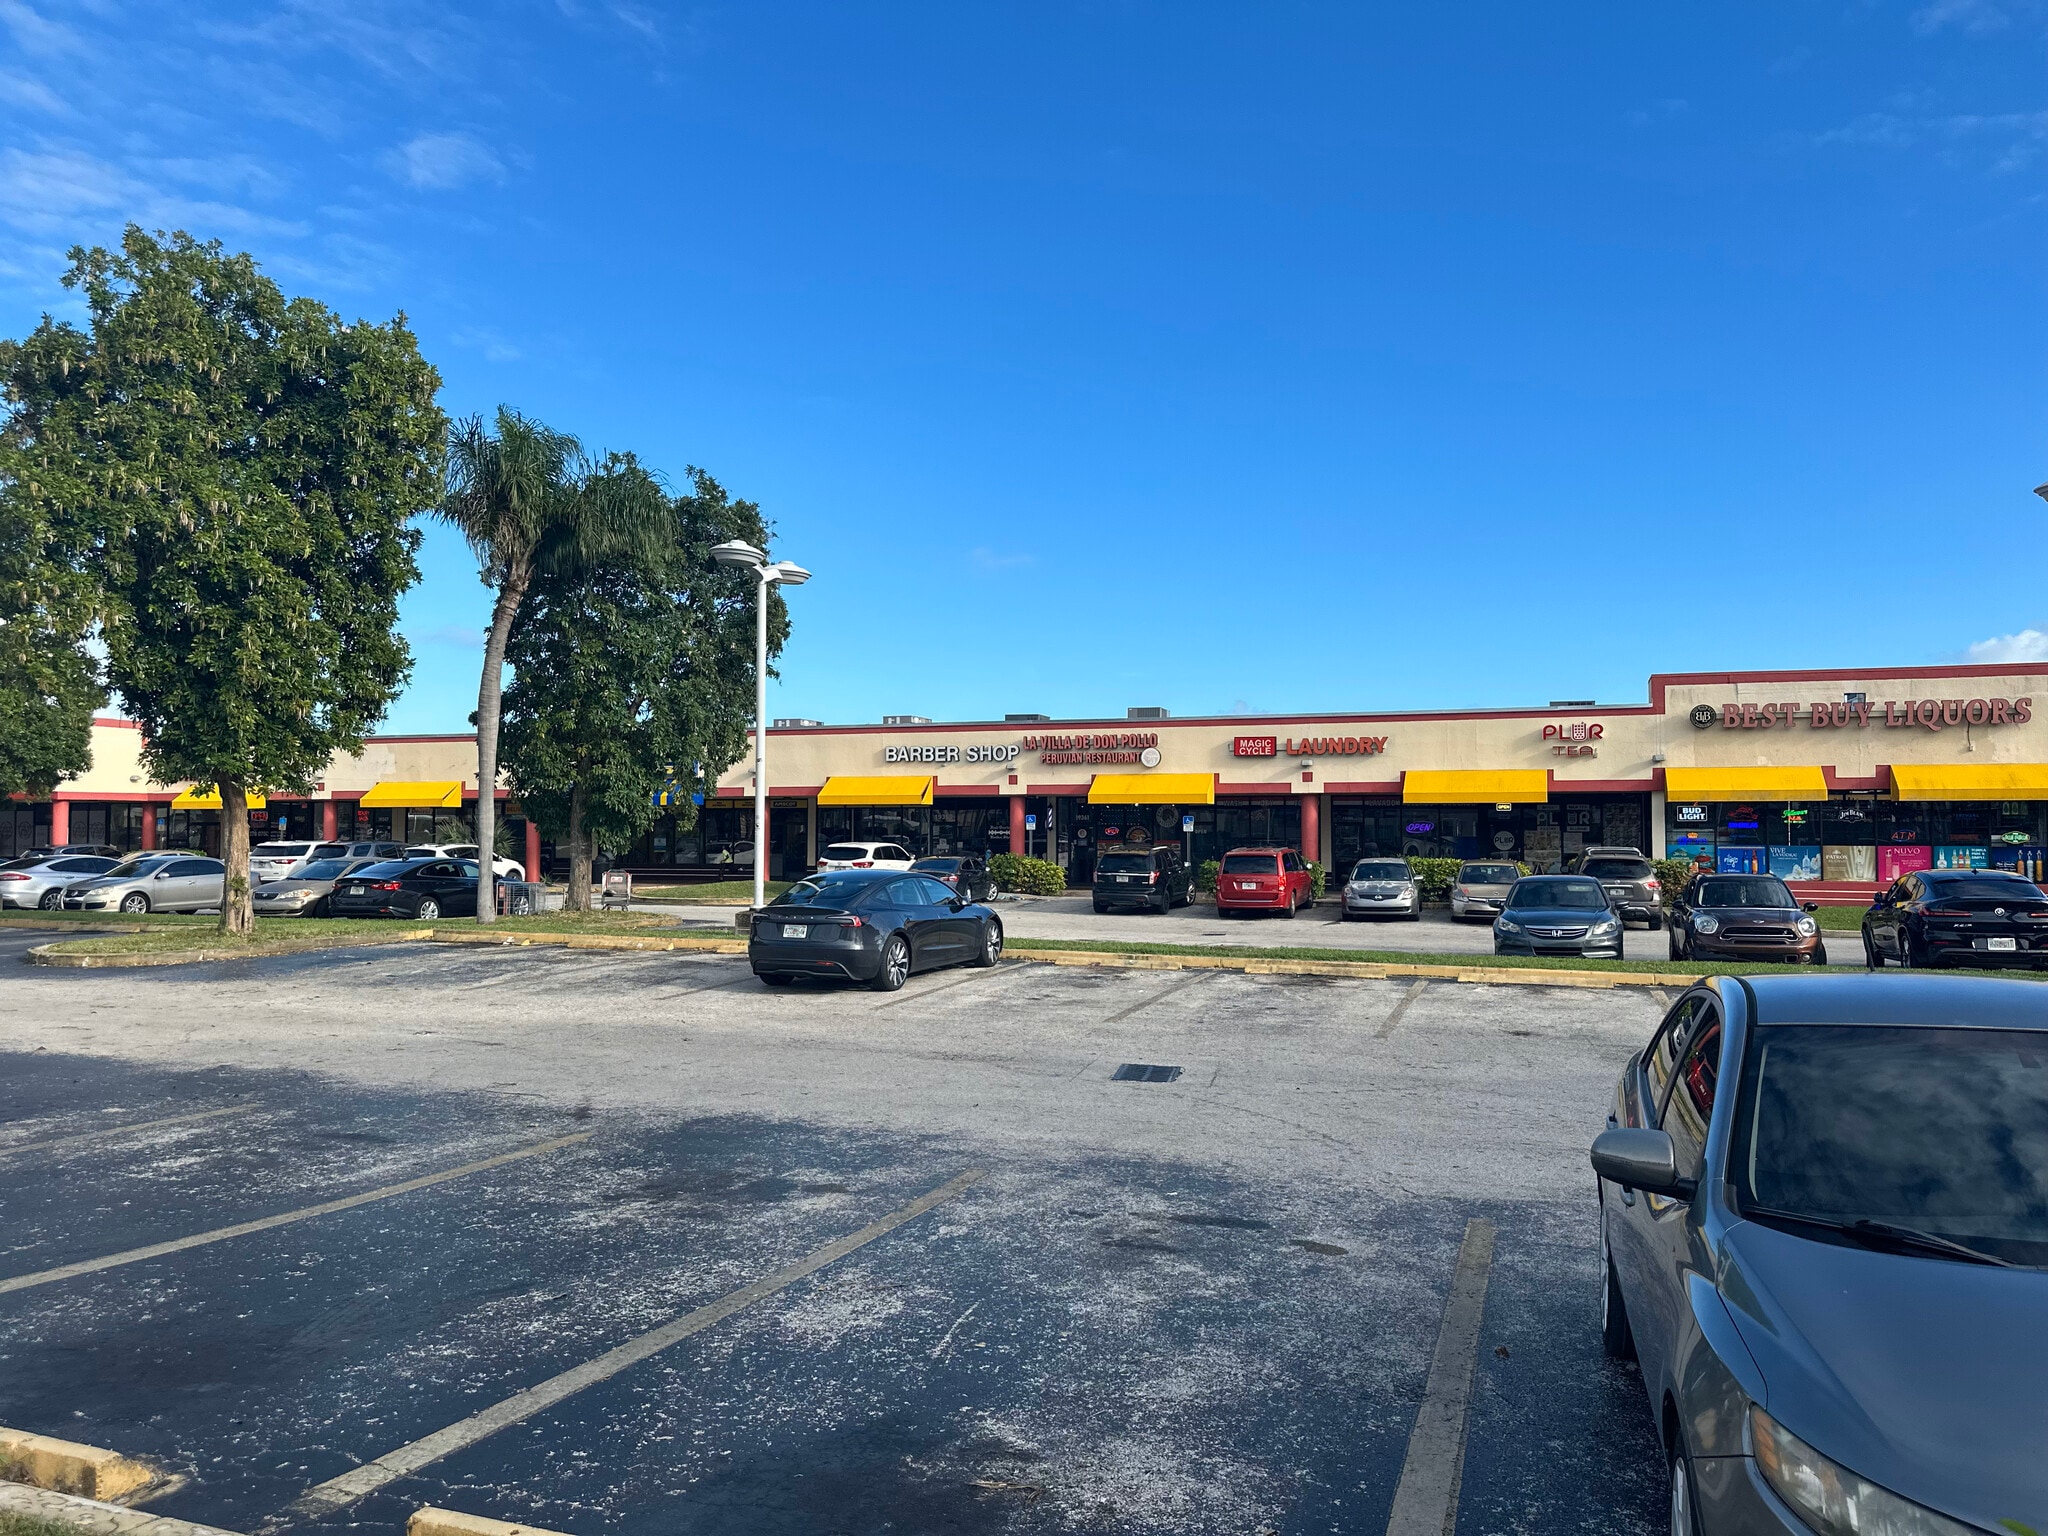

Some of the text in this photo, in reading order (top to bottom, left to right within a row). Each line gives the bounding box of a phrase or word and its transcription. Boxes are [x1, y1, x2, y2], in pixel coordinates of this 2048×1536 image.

[1722, 698, 2032, 732] BEST BUY LIQUORS
[1542, 722, 1604, 741] PLUR
[1023, 733, 1158, 750] LA VILLA DE DON POLLO
[1239, 739, 1272, 748] MAGIC
[1286, 736, 1389, 755] LAUNDRY
[885, 745, 1020, 762] BARBER SHOP
[1239, 747, 1272, 755] CYCLE
[1552, 745, 1594, 756] TEA
[1040, 751, 1141, 764] PERUVIAN RESTAURANT
[1408, 823, 1432, 832] OPEN
[1891, 831, 1916, 840] ATM
[1893, 847, 1921, 855] NUVO
